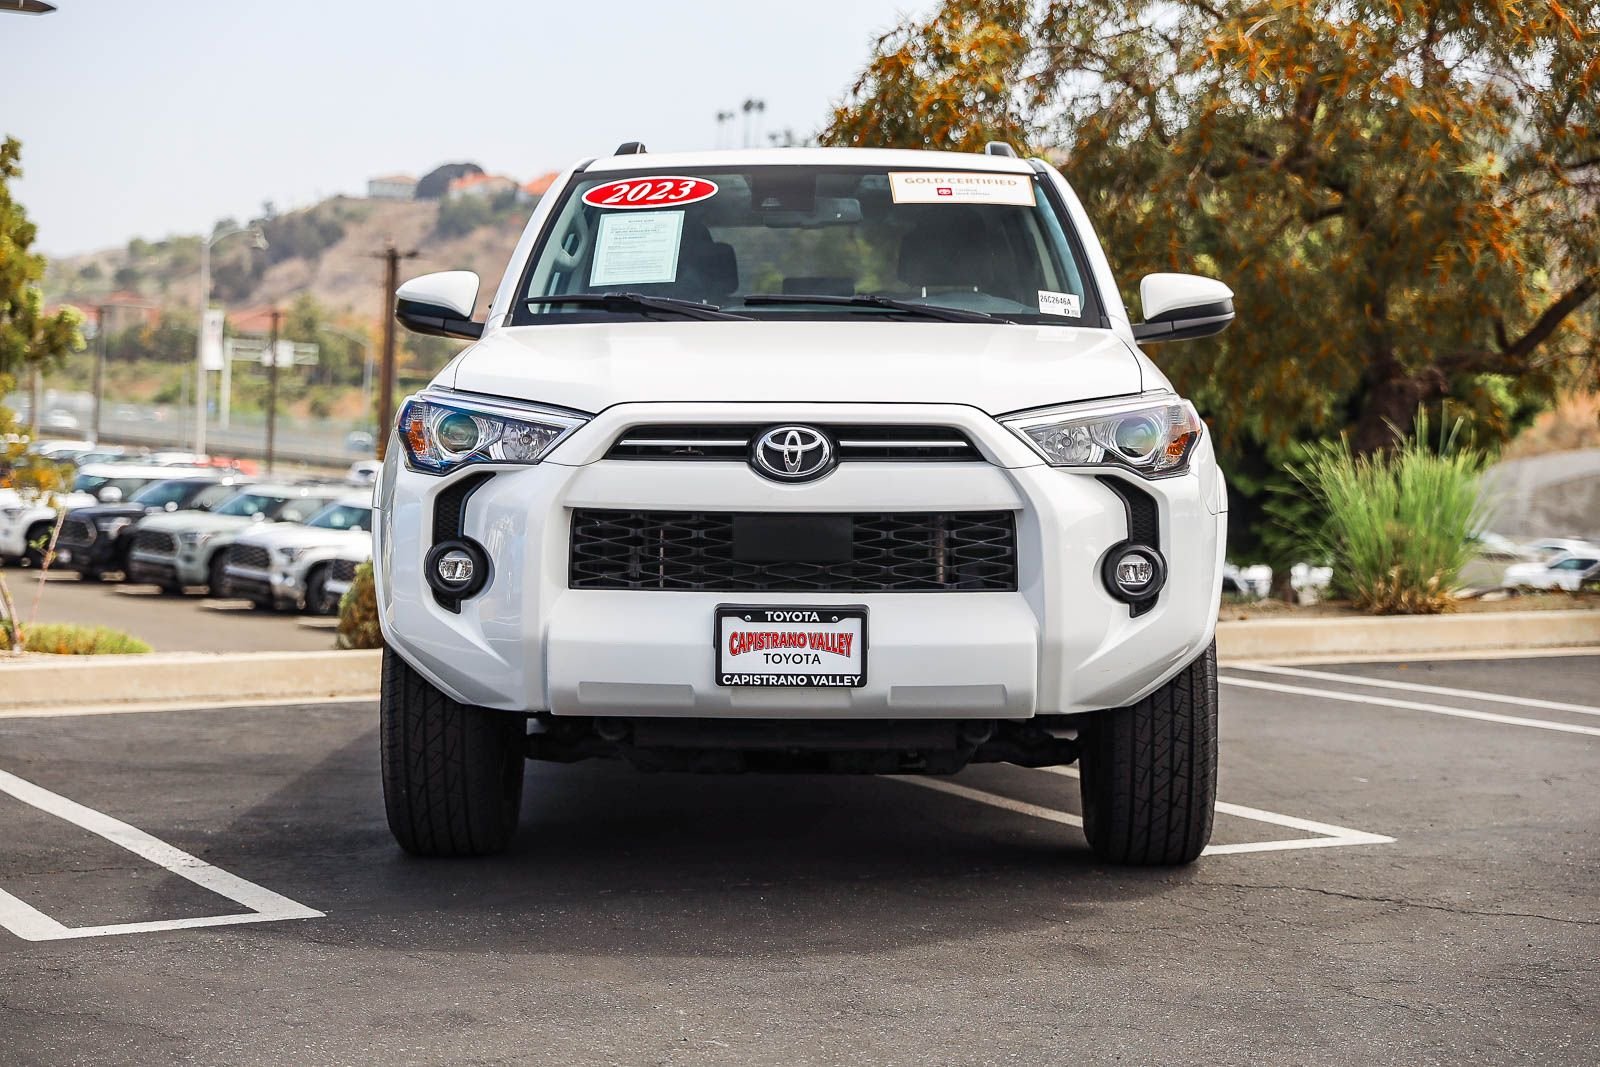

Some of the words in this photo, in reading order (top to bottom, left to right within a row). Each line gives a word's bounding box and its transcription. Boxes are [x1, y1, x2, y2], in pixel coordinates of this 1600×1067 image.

[904, 176, 944, 185] GOLD
[946, 177, 1018, 187] CERTIFIED
[601, 180, 697, 204] 2023
[765, 611, 820, 622] TOYOTA
[728, 631, 808, 657] CAPISTRANO
[806, 632, 854, 658] VALLEY
[763, 653, 822, 665] TOYOTA
[722, 674, 808, 686] CAPISTRANO
[810, 675, 861, 686] VALLEY
